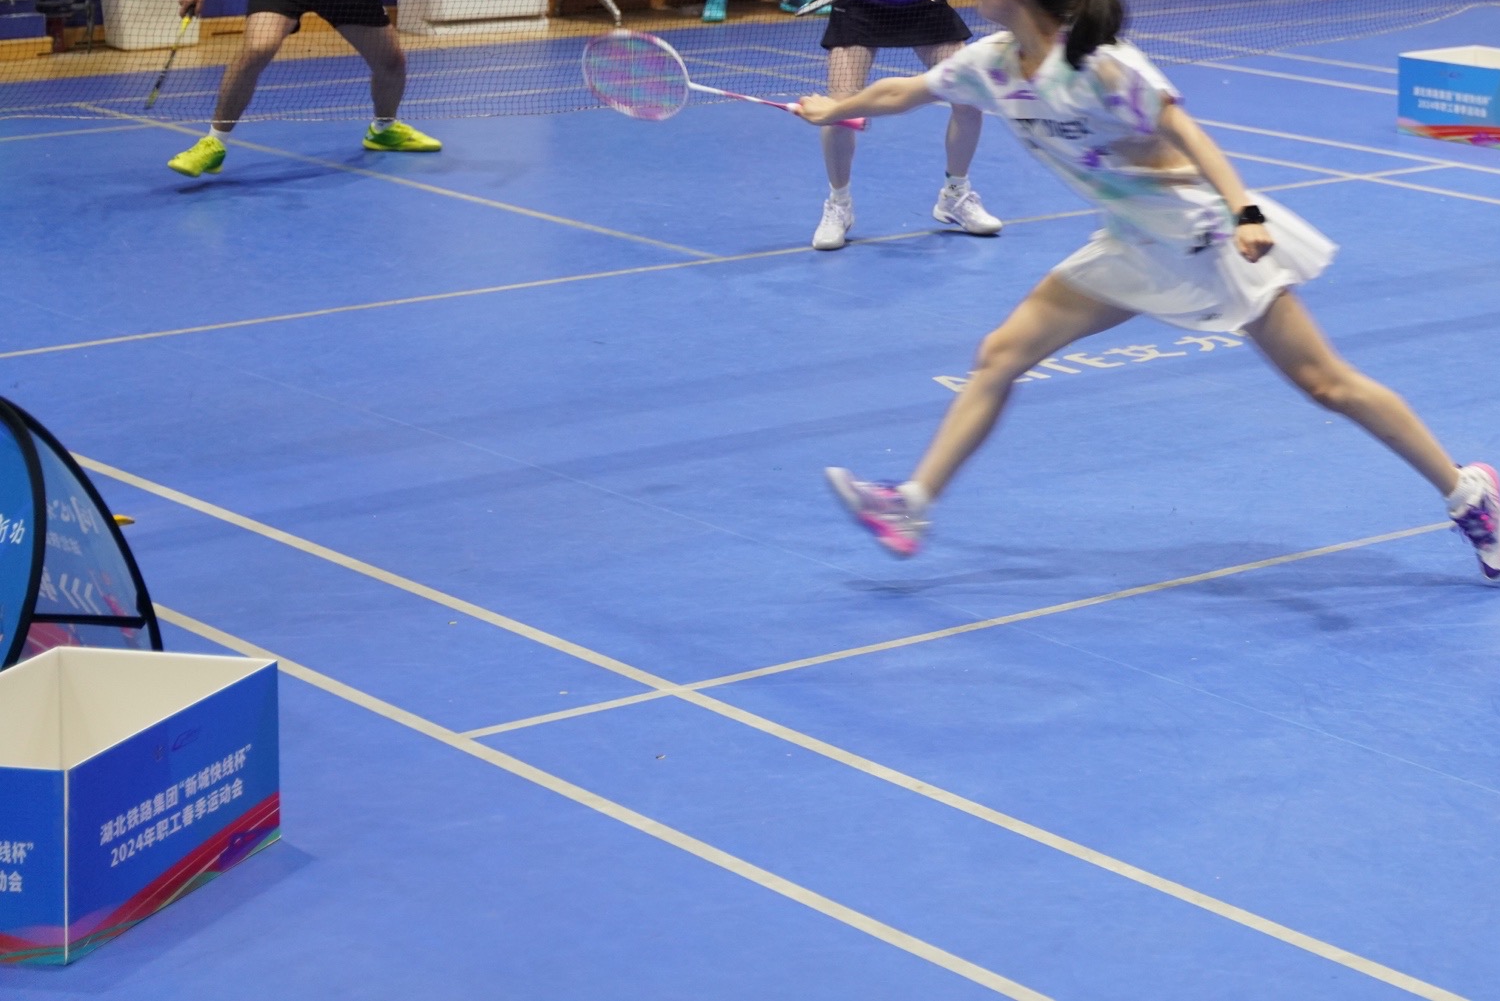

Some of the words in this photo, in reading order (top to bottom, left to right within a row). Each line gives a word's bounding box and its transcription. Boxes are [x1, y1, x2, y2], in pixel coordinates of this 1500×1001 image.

[99, 743, 252, 846] 湖北铁路集团“新城快线杯”
[110, 777, 244, 868] 2024年职工春季运动会
